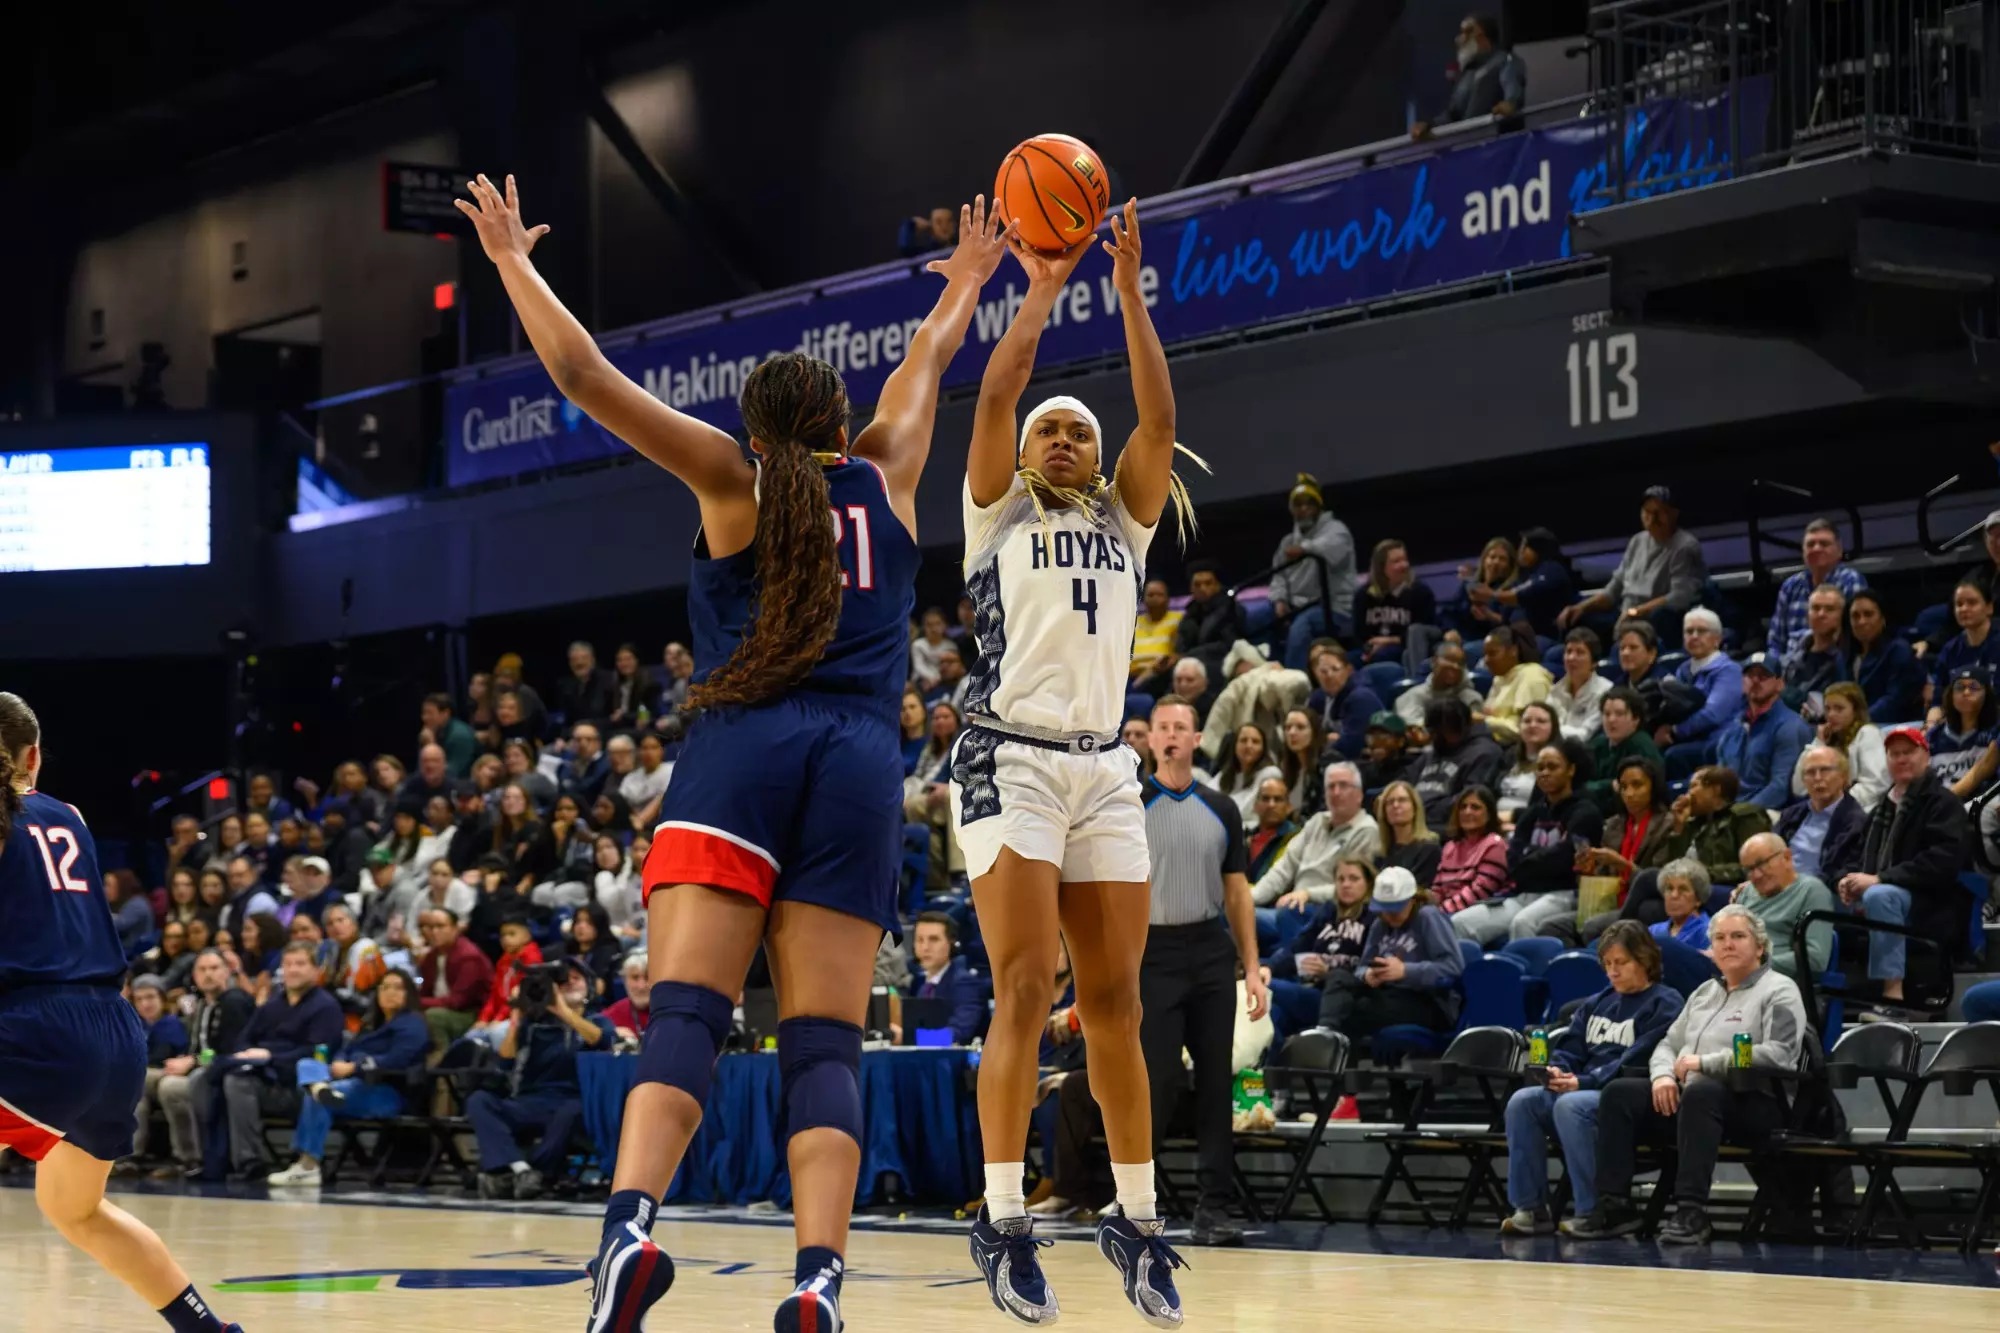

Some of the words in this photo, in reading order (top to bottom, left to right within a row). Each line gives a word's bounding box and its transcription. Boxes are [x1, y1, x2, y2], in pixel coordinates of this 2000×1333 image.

[974, 284, 1092, 344] whre
[1171, 218, 1279, 304] live,
[1290, 164, 1448, 277] work
[1461, 160, 1551, 239] and
[1565, 332, 1638, 428] 113
[463, 394, 559, 453] CareFirst
[1031, 530, 1126, 573] HOYAS
[1072, 578, 1098, 635] 4
[1077, 734, 1095, 752] G
[26, 824, 89, 893] 12
